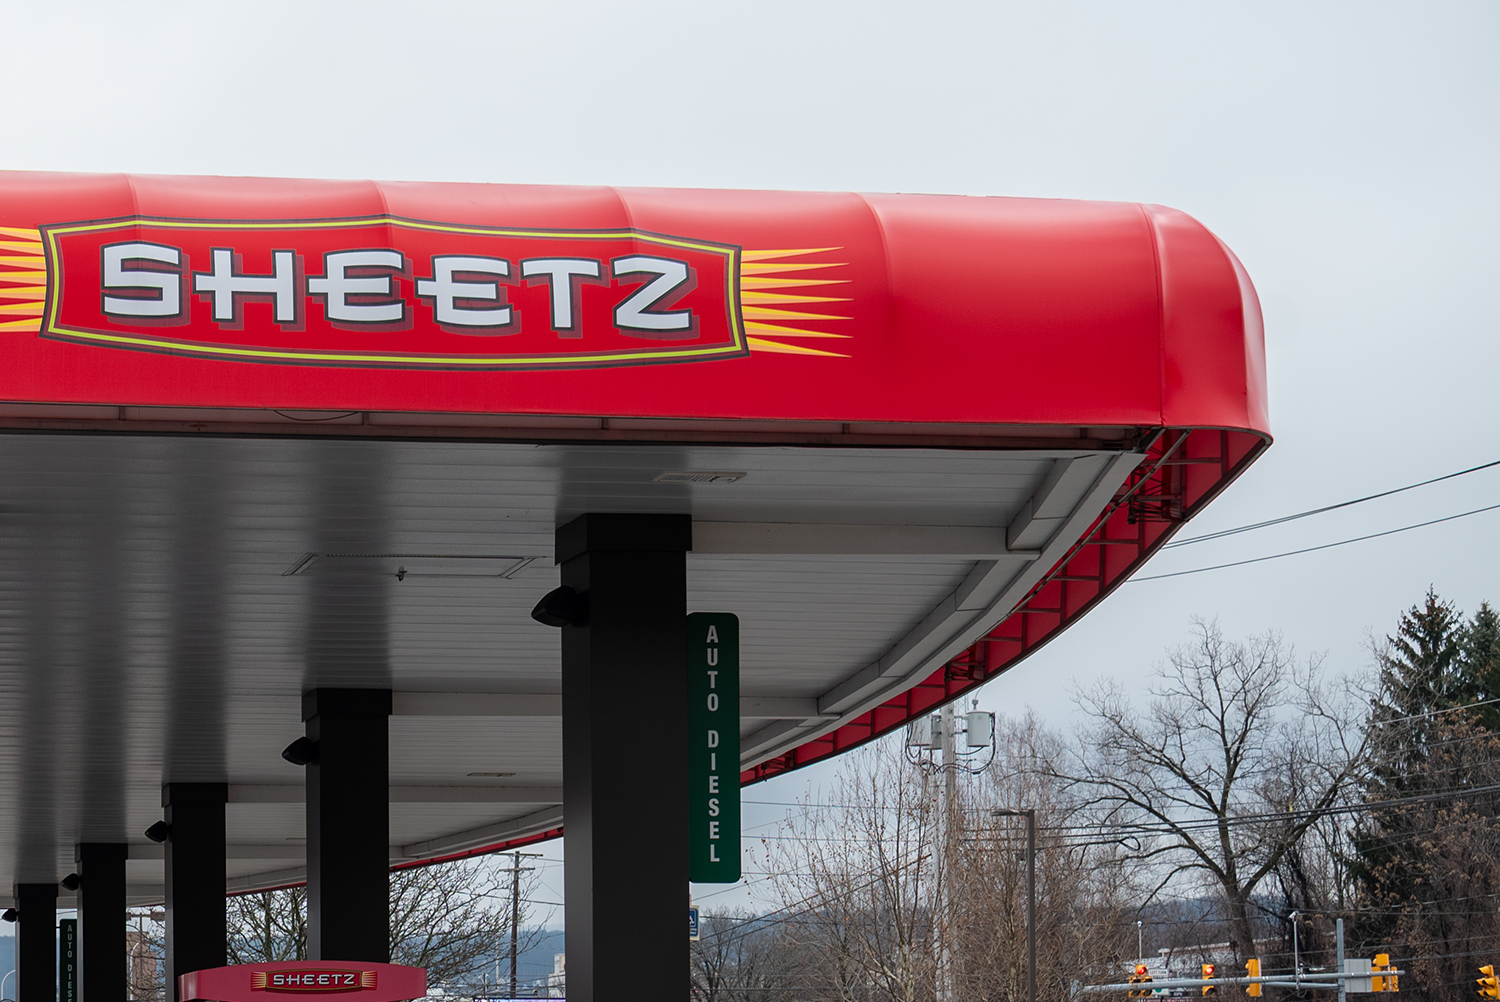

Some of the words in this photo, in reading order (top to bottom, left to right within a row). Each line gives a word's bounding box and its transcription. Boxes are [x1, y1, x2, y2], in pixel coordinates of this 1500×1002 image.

[102, 243, 694, 331] SHEETZ
[706, 625, 719, 712] AUTO
[707, 730, 720, 862] DIESEL
[273, 974, 355, 986] SHEETZ
